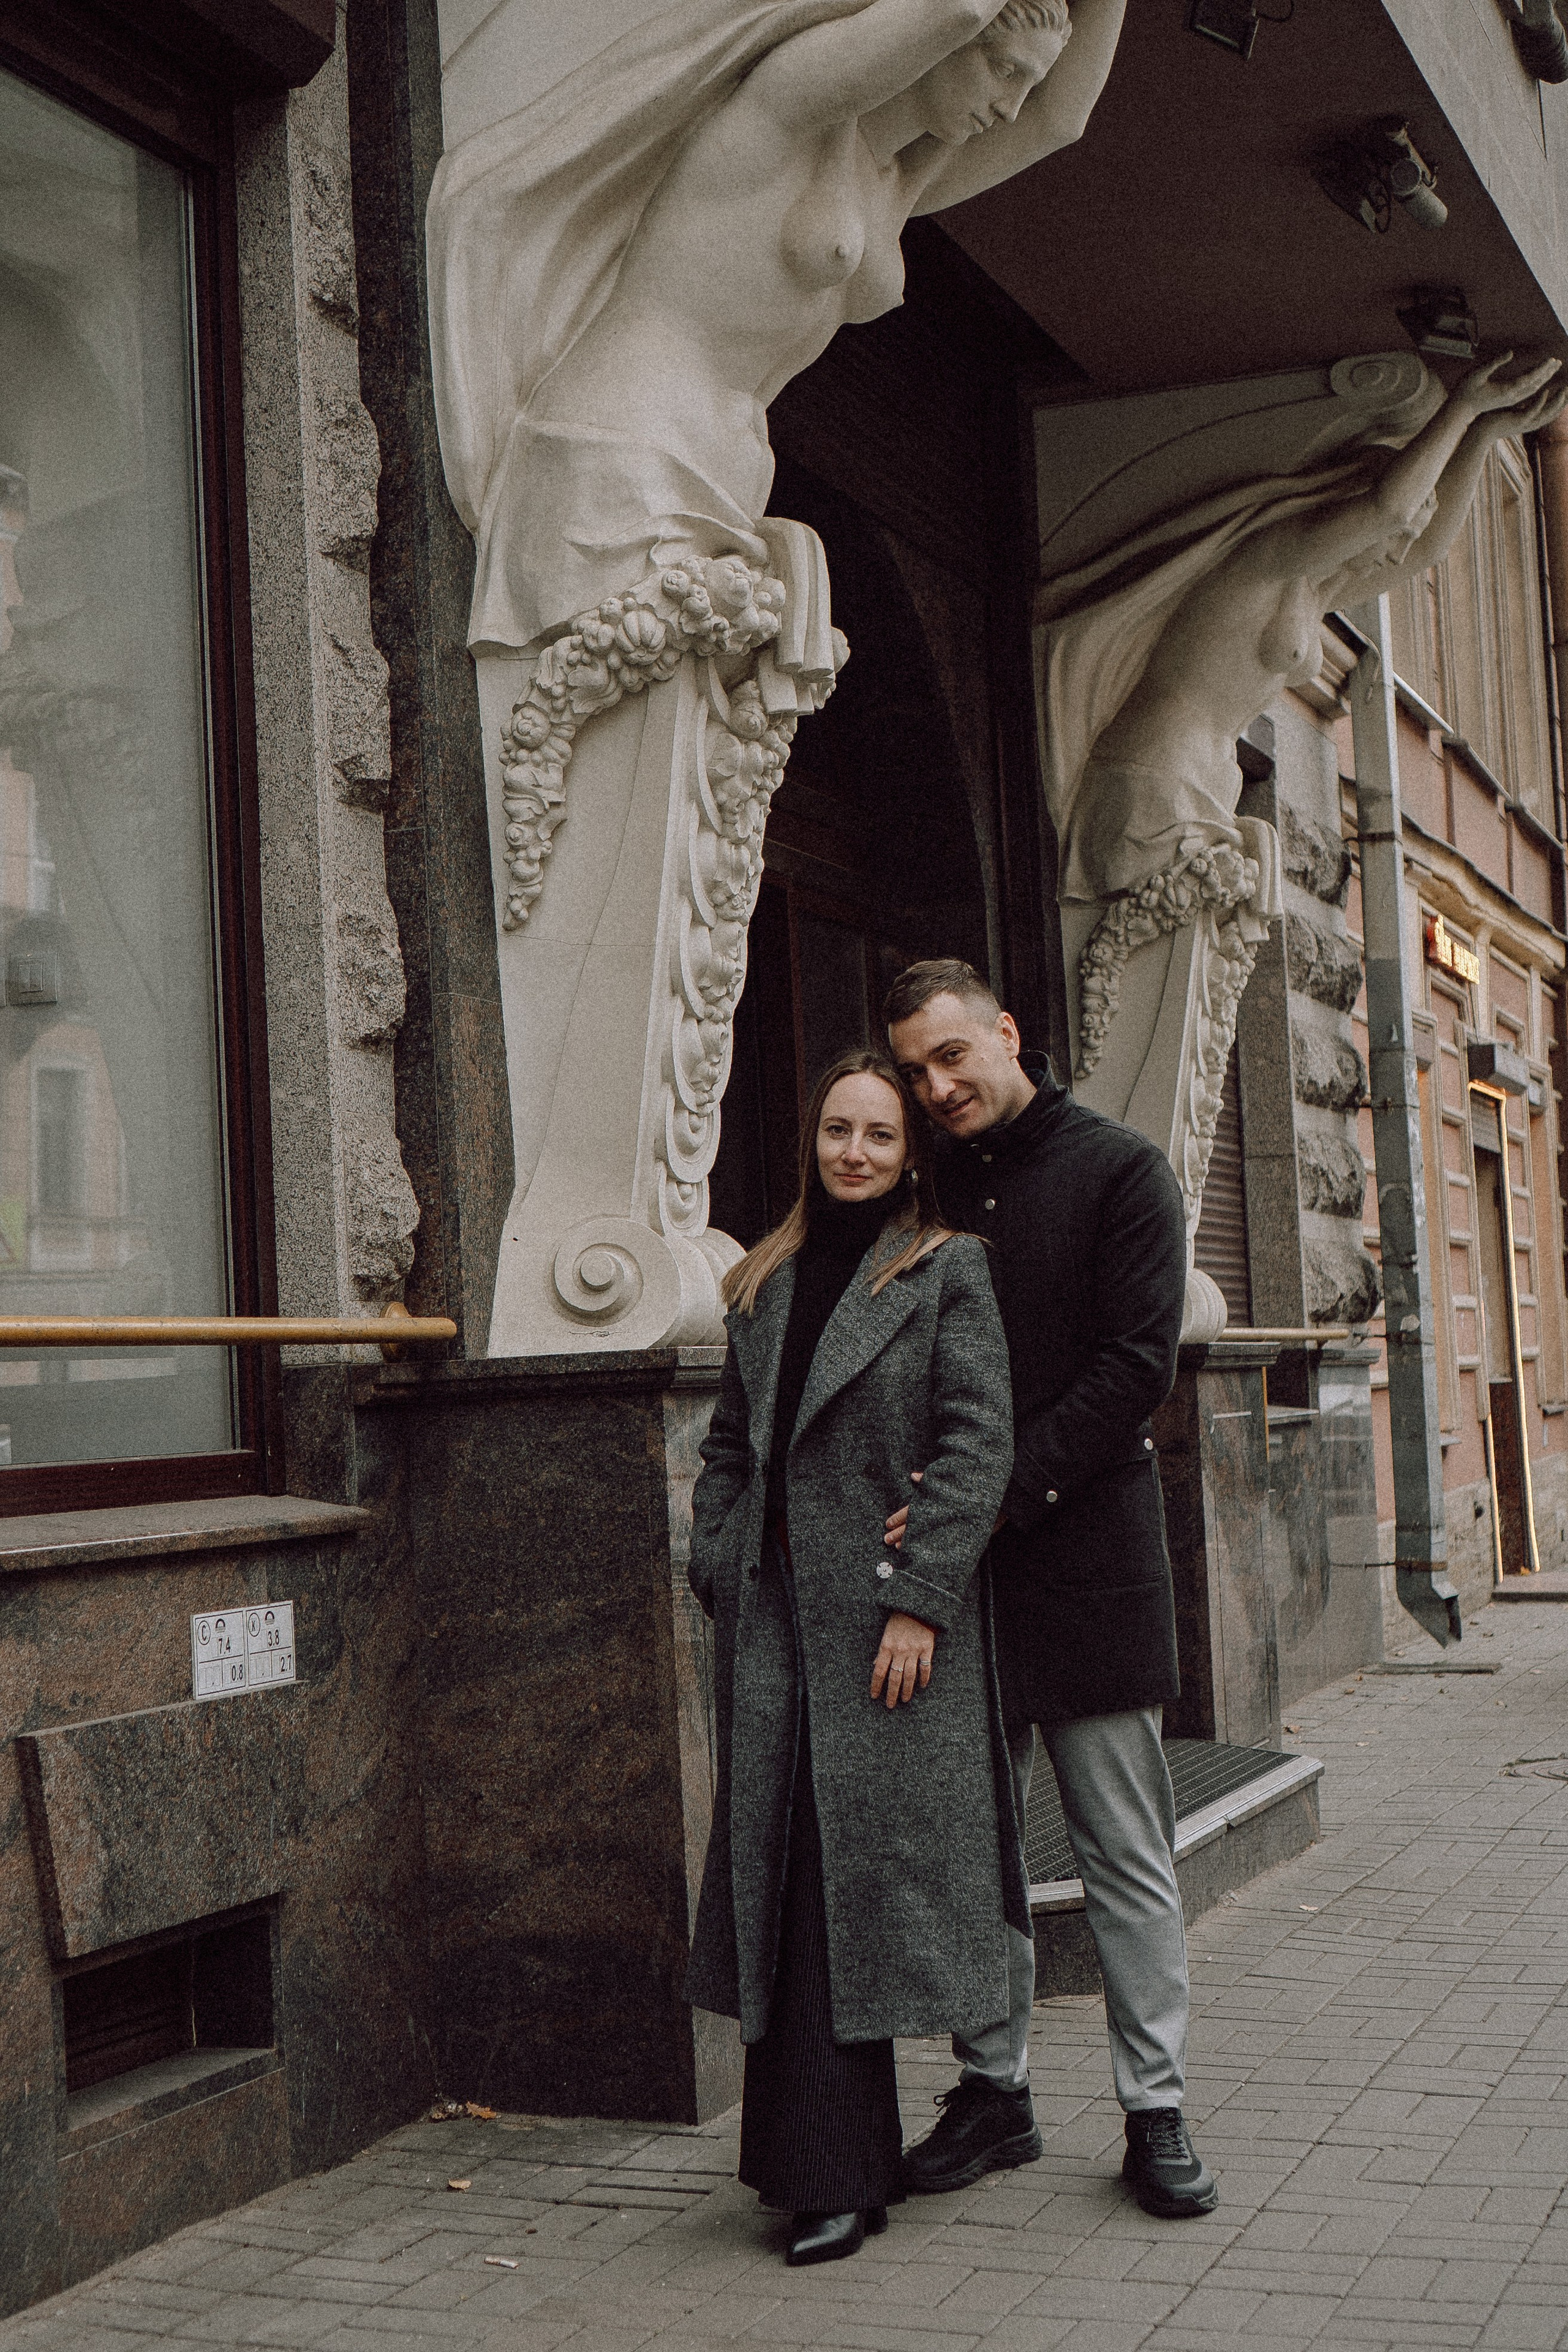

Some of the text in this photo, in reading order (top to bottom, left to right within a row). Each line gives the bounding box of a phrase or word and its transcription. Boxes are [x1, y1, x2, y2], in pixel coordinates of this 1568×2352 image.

[218, 1637, 231, 1654] 7.4
[268, 1629, 280, 1647] 3.8
[281, 1654, 292, 1673] 2.7
[232, 1664, 243, 1681] 0.8
